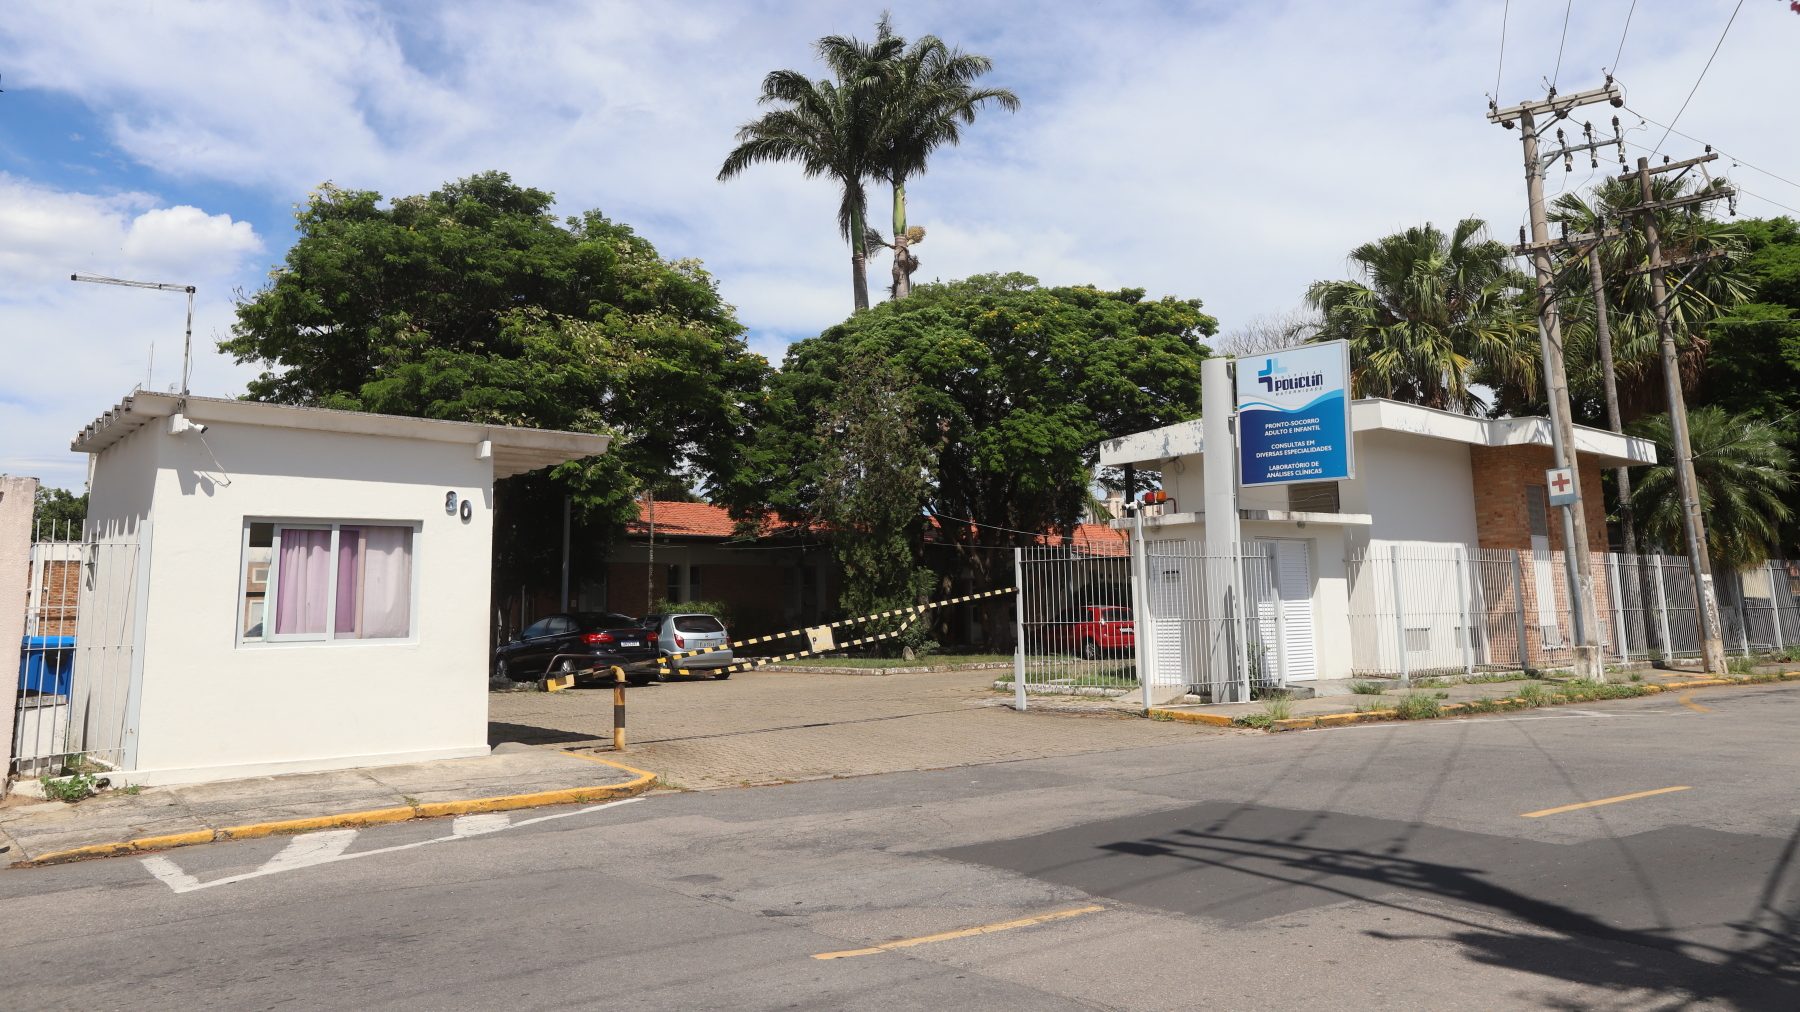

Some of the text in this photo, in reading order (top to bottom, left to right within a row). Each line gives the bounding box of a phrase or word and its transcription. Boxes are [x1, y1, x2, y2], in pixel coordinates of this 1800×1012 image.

[1265, 418, 1320, 429] PRONTO-SOCORRO
[1294, 425, 1321, 433] INFANTIL
[1271, 441, 1305, 449] CONSULTAS
[1284, 445, 1332, 455] ESPECIALIDADES
[1269, 461, 1310, 471] LABORATÓRIO
[1266, 468, 1322, 478] ANÁLISES CLÍNICAS
[445, 491, 472, 524] 80
